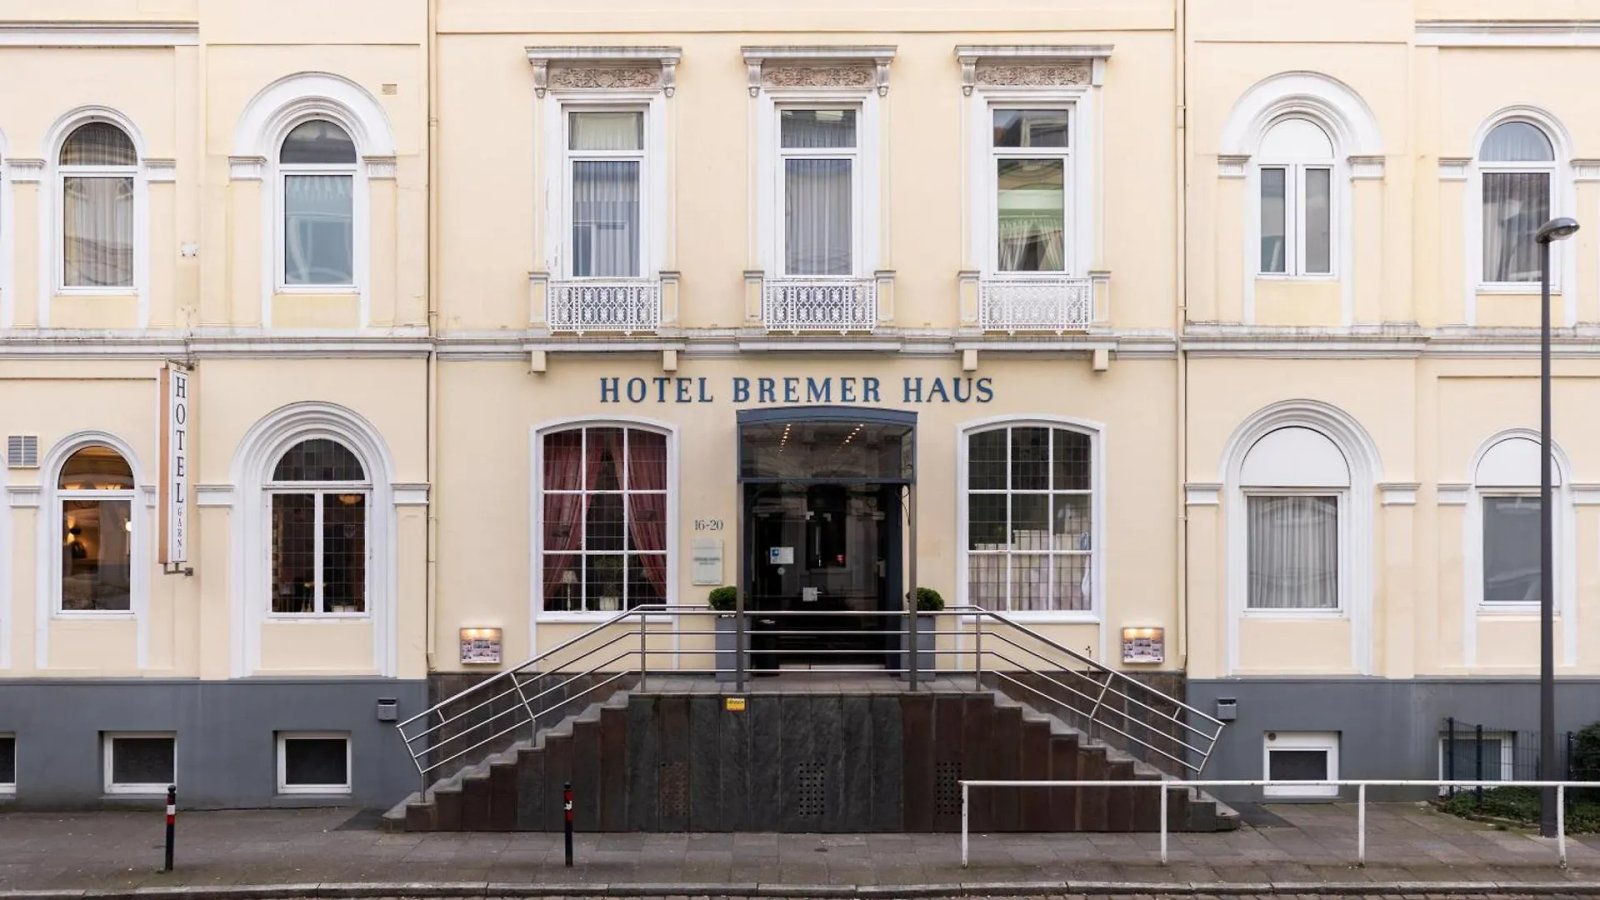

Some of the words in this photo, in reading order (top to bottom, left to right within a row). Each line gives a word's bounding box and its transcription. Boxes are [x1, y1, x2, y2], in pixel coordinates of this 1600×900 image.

[600, 377, 713, 403] HOTEL
[733, 377, 881, 403] BREMER
[903, 377, 994, 403] HAUS
[175, 376, 185, 503] HOTEL
[694, 519, 723, 531] 16-20
